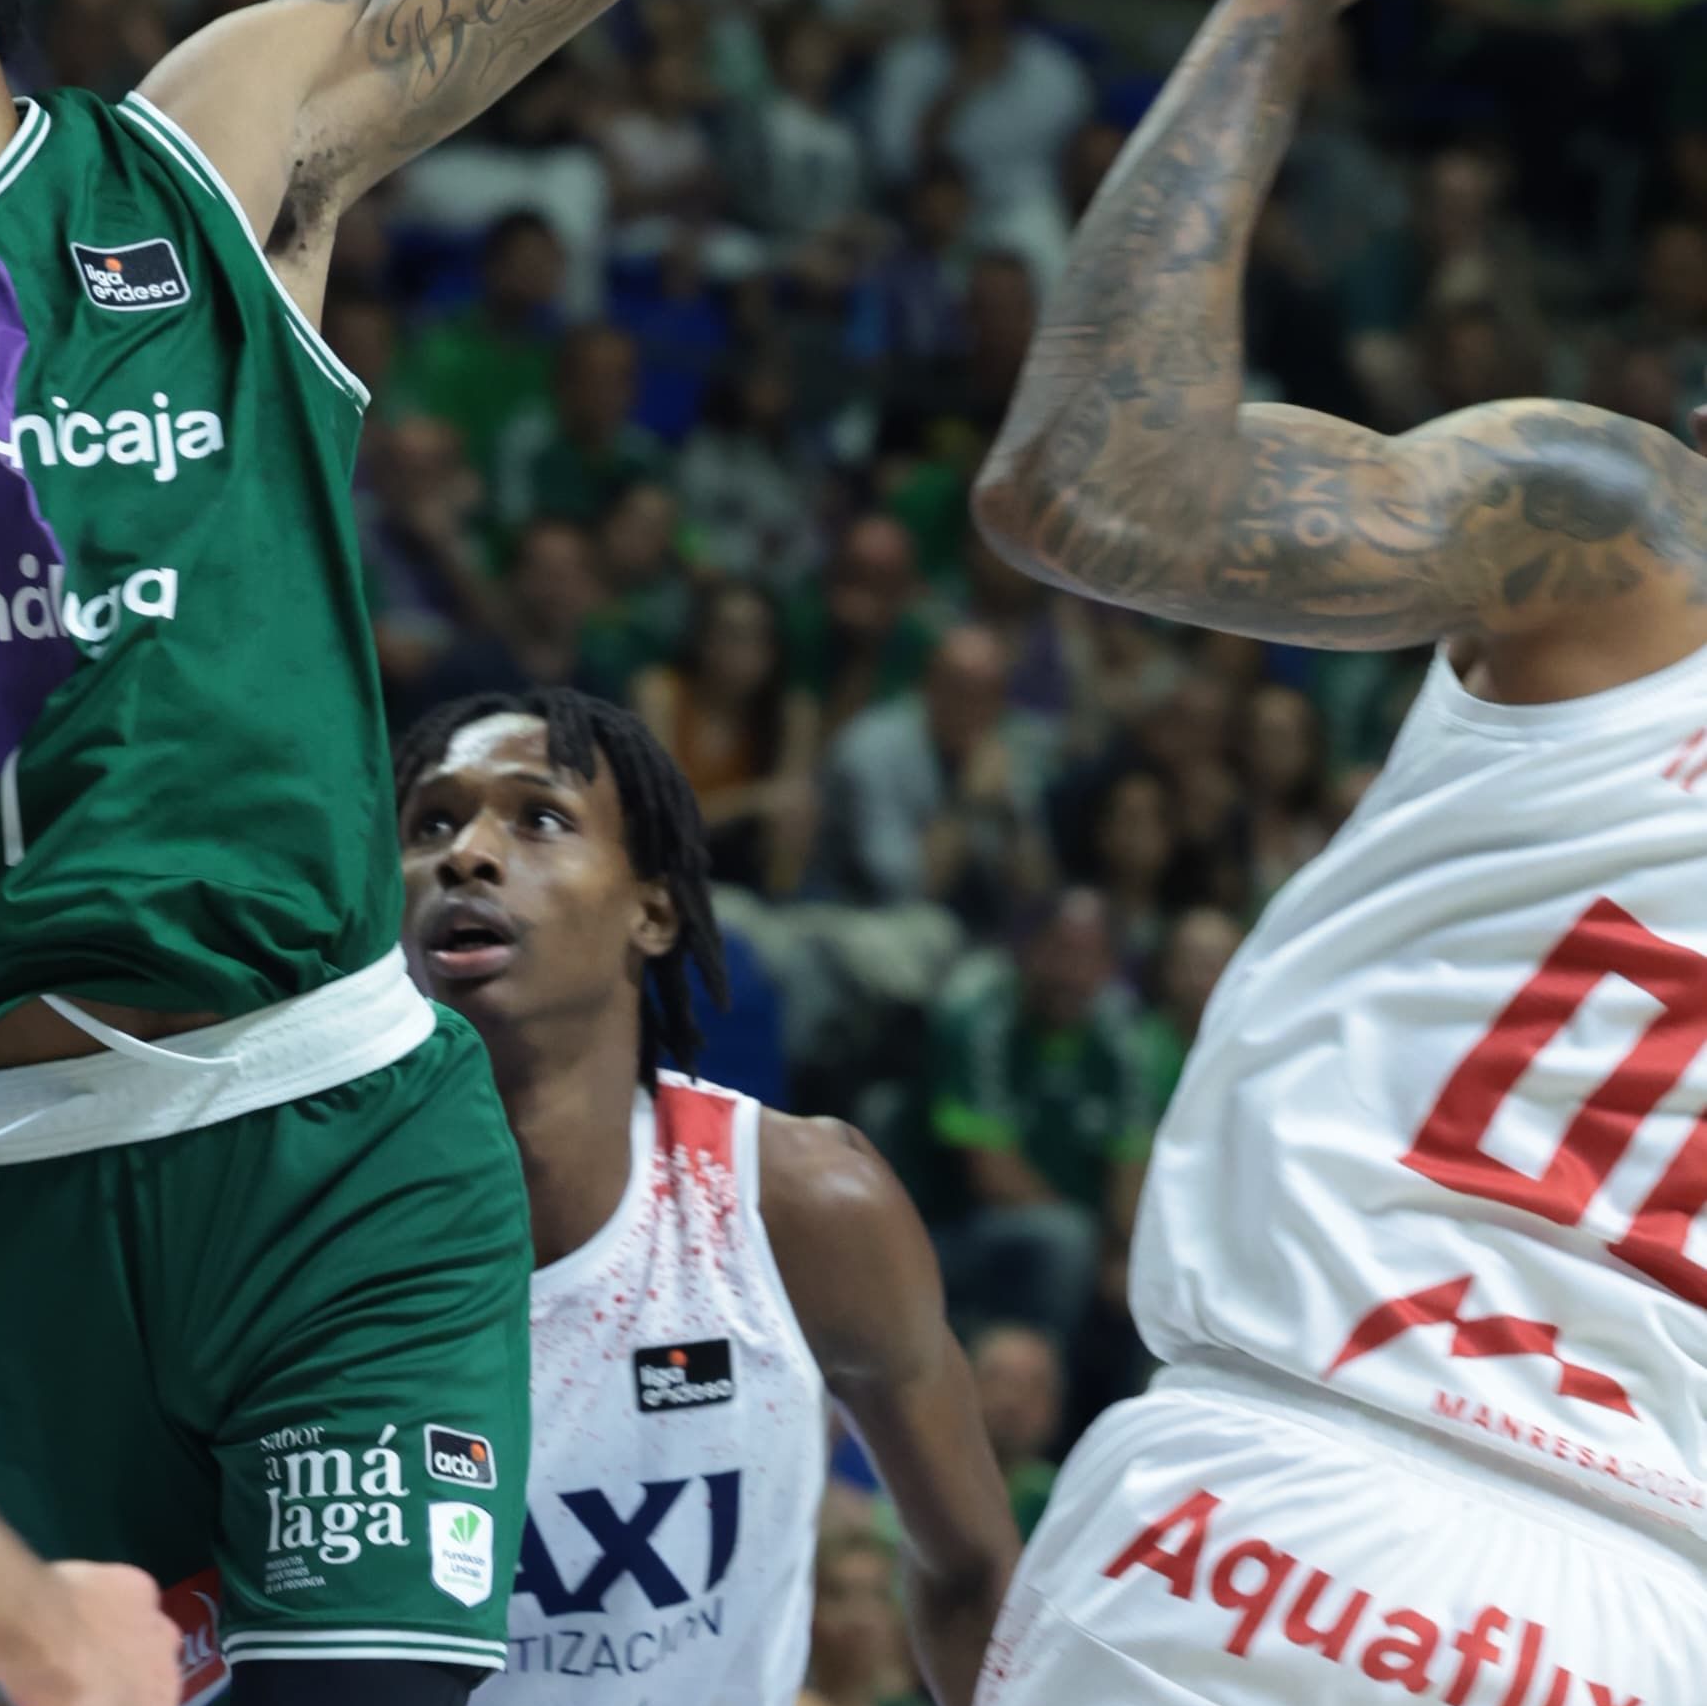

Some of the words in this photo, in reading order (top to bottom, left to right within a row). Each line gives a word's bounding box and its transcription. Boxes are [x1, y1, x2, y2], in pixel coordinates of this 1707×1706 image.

[84, 263, 125, 288] liga
[92, 280, 180, 302] endesa
[434, 1449, 479, 1479] acb
[513, 1470, 741, 1617] AXI
